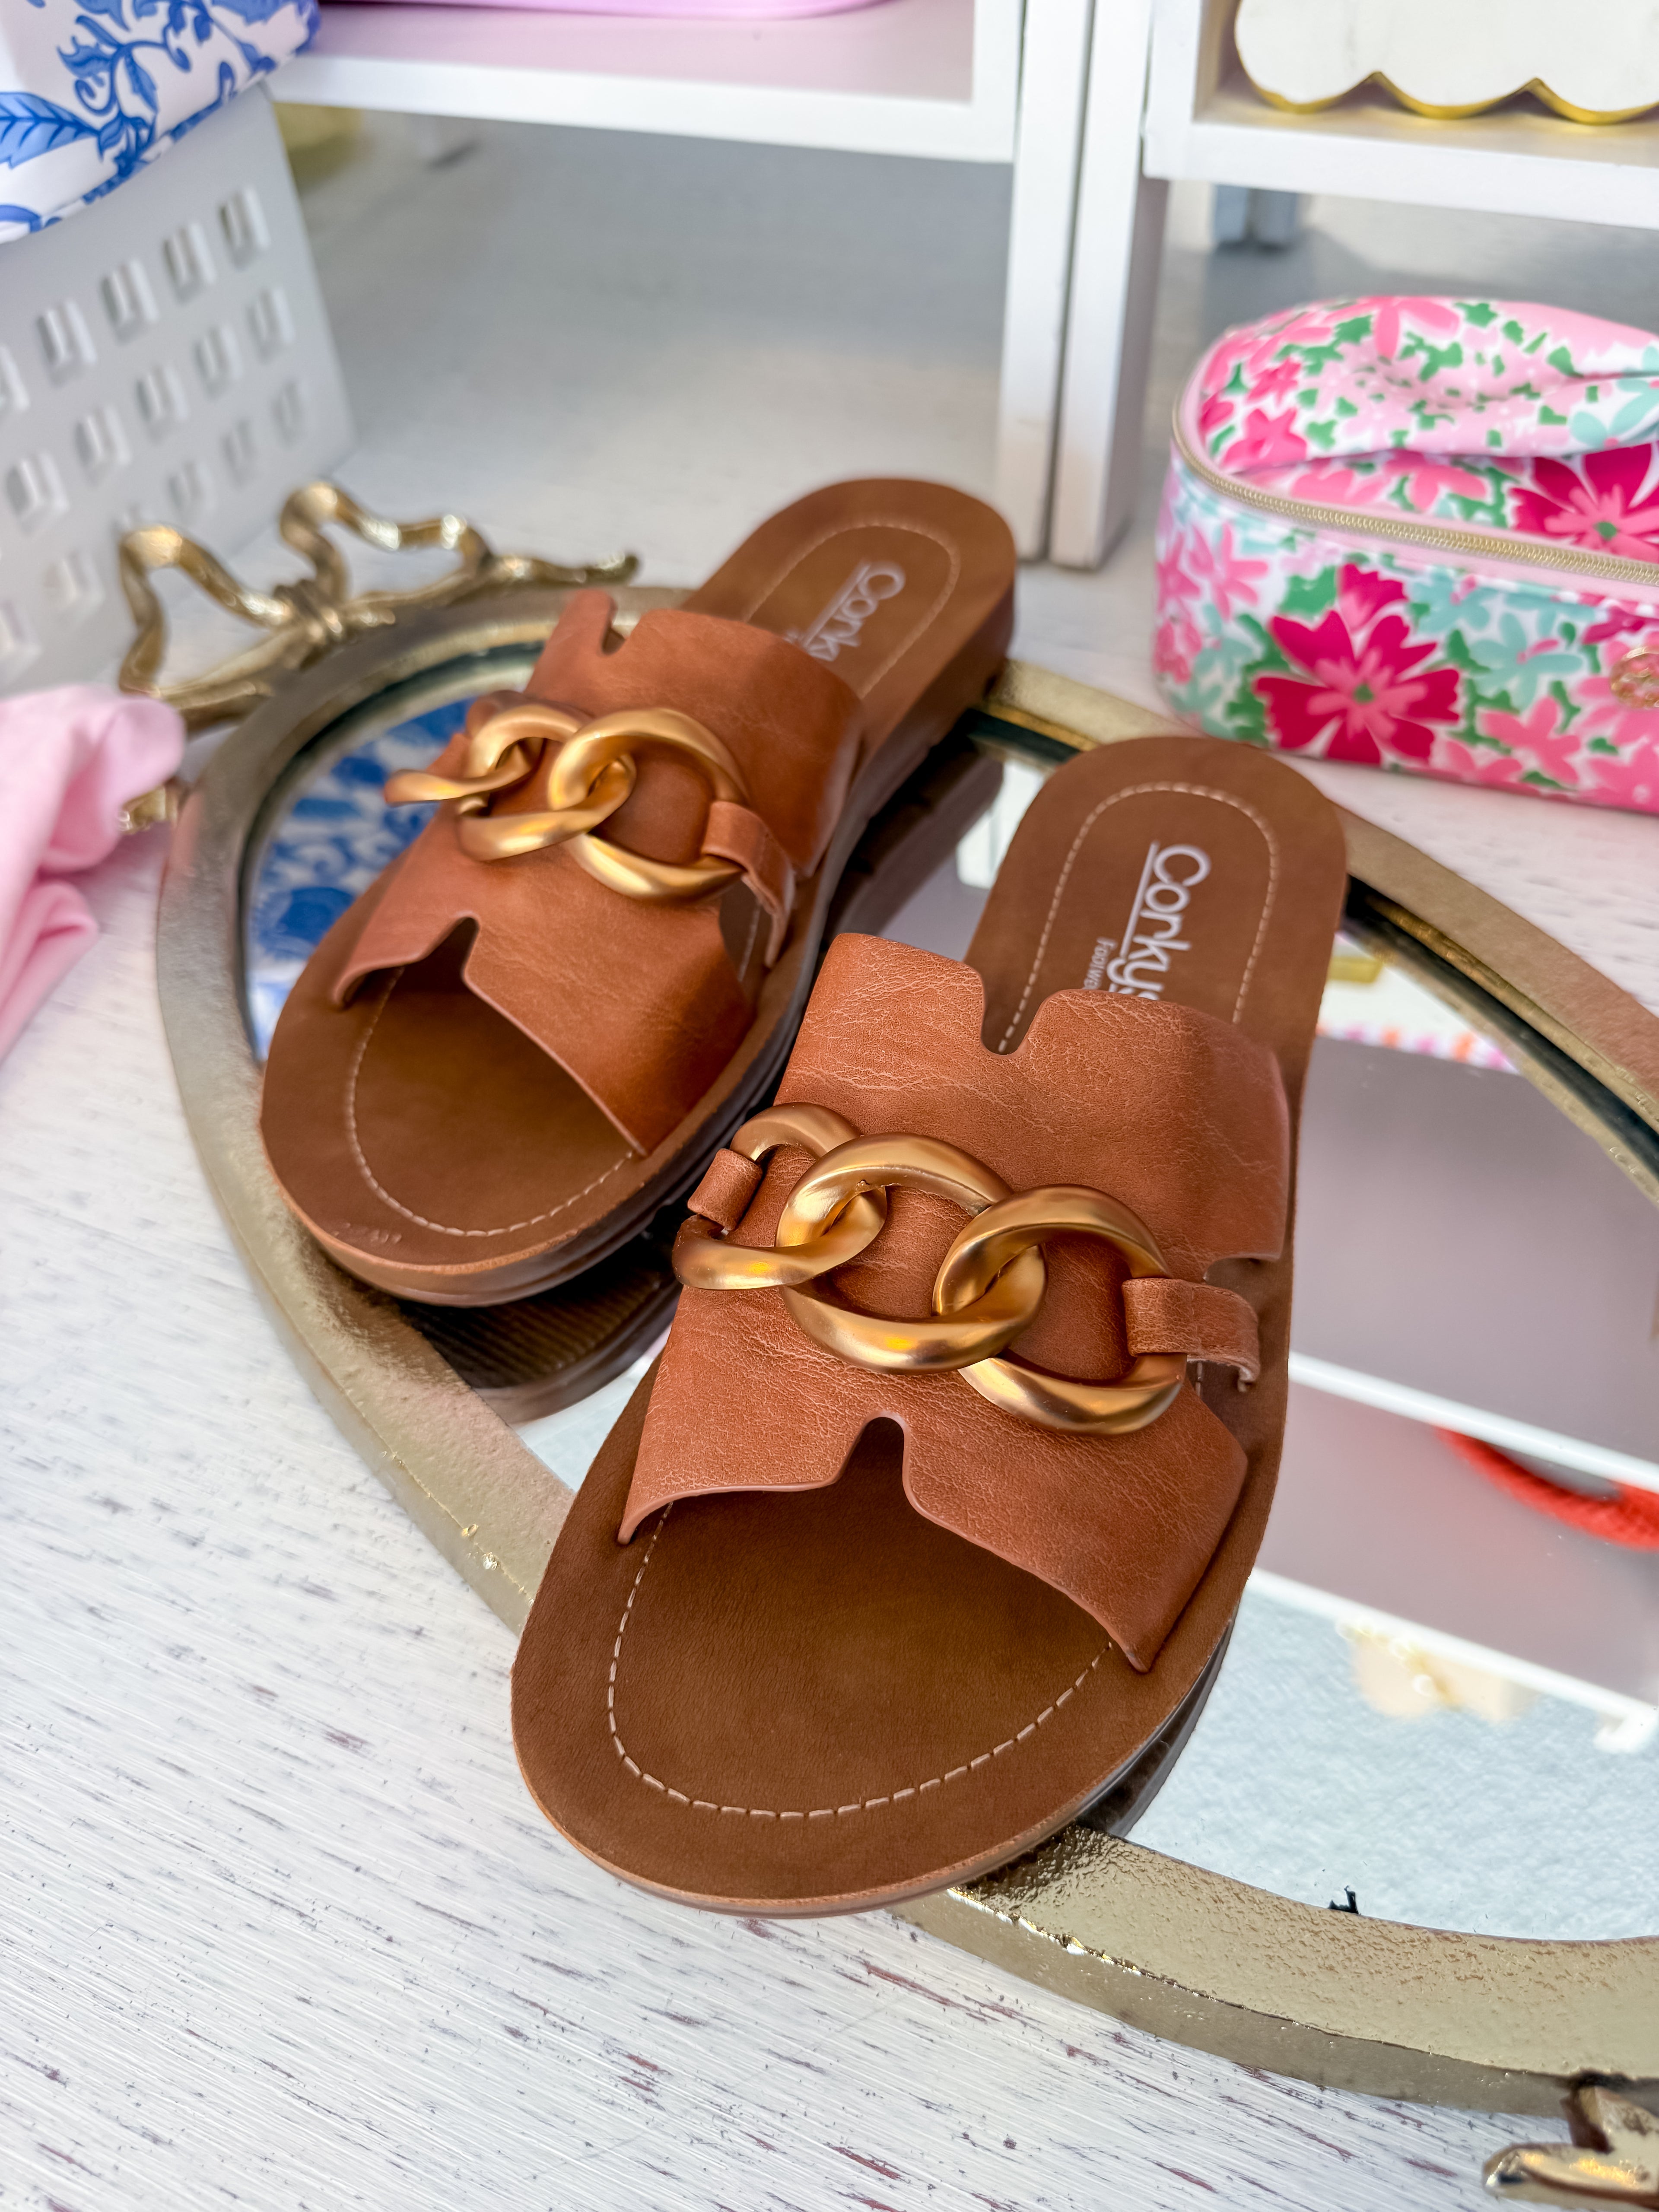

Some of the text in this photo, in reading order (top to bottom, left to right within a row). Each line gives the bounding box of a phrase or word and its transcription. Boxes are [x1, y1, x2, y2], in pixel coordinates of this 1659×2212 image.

[807, 560, 906, 661] Cork
[1082, 936, 1119, 990] Footwe
[1106, 844, 1211, 1000] Corky
